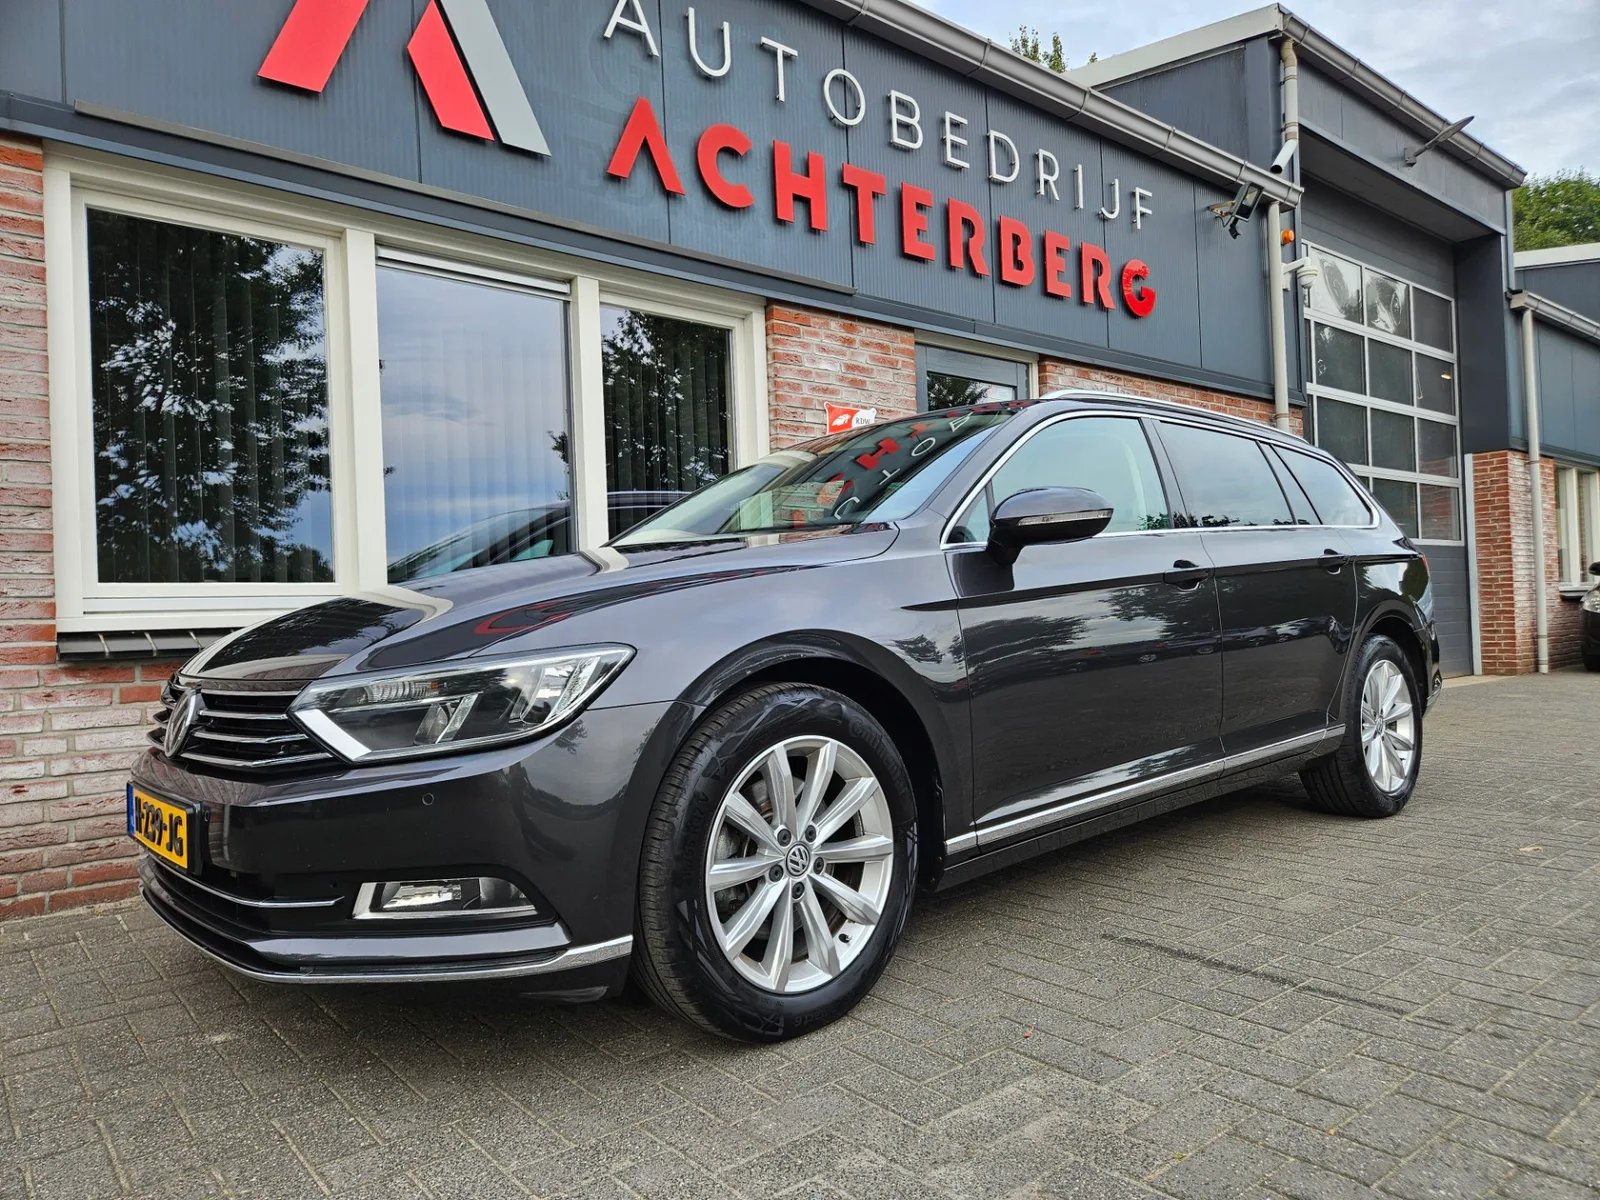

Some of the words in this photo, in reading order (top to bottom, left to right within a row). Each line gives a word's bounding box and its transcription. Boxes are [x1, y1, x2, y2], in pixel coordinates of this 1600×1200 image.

[603, 0, 1154, 230] AUTOBEDRIJF
[607, 96, 1157, 318] ACHTERBERG
[855, 417, 871, 425] RDW
